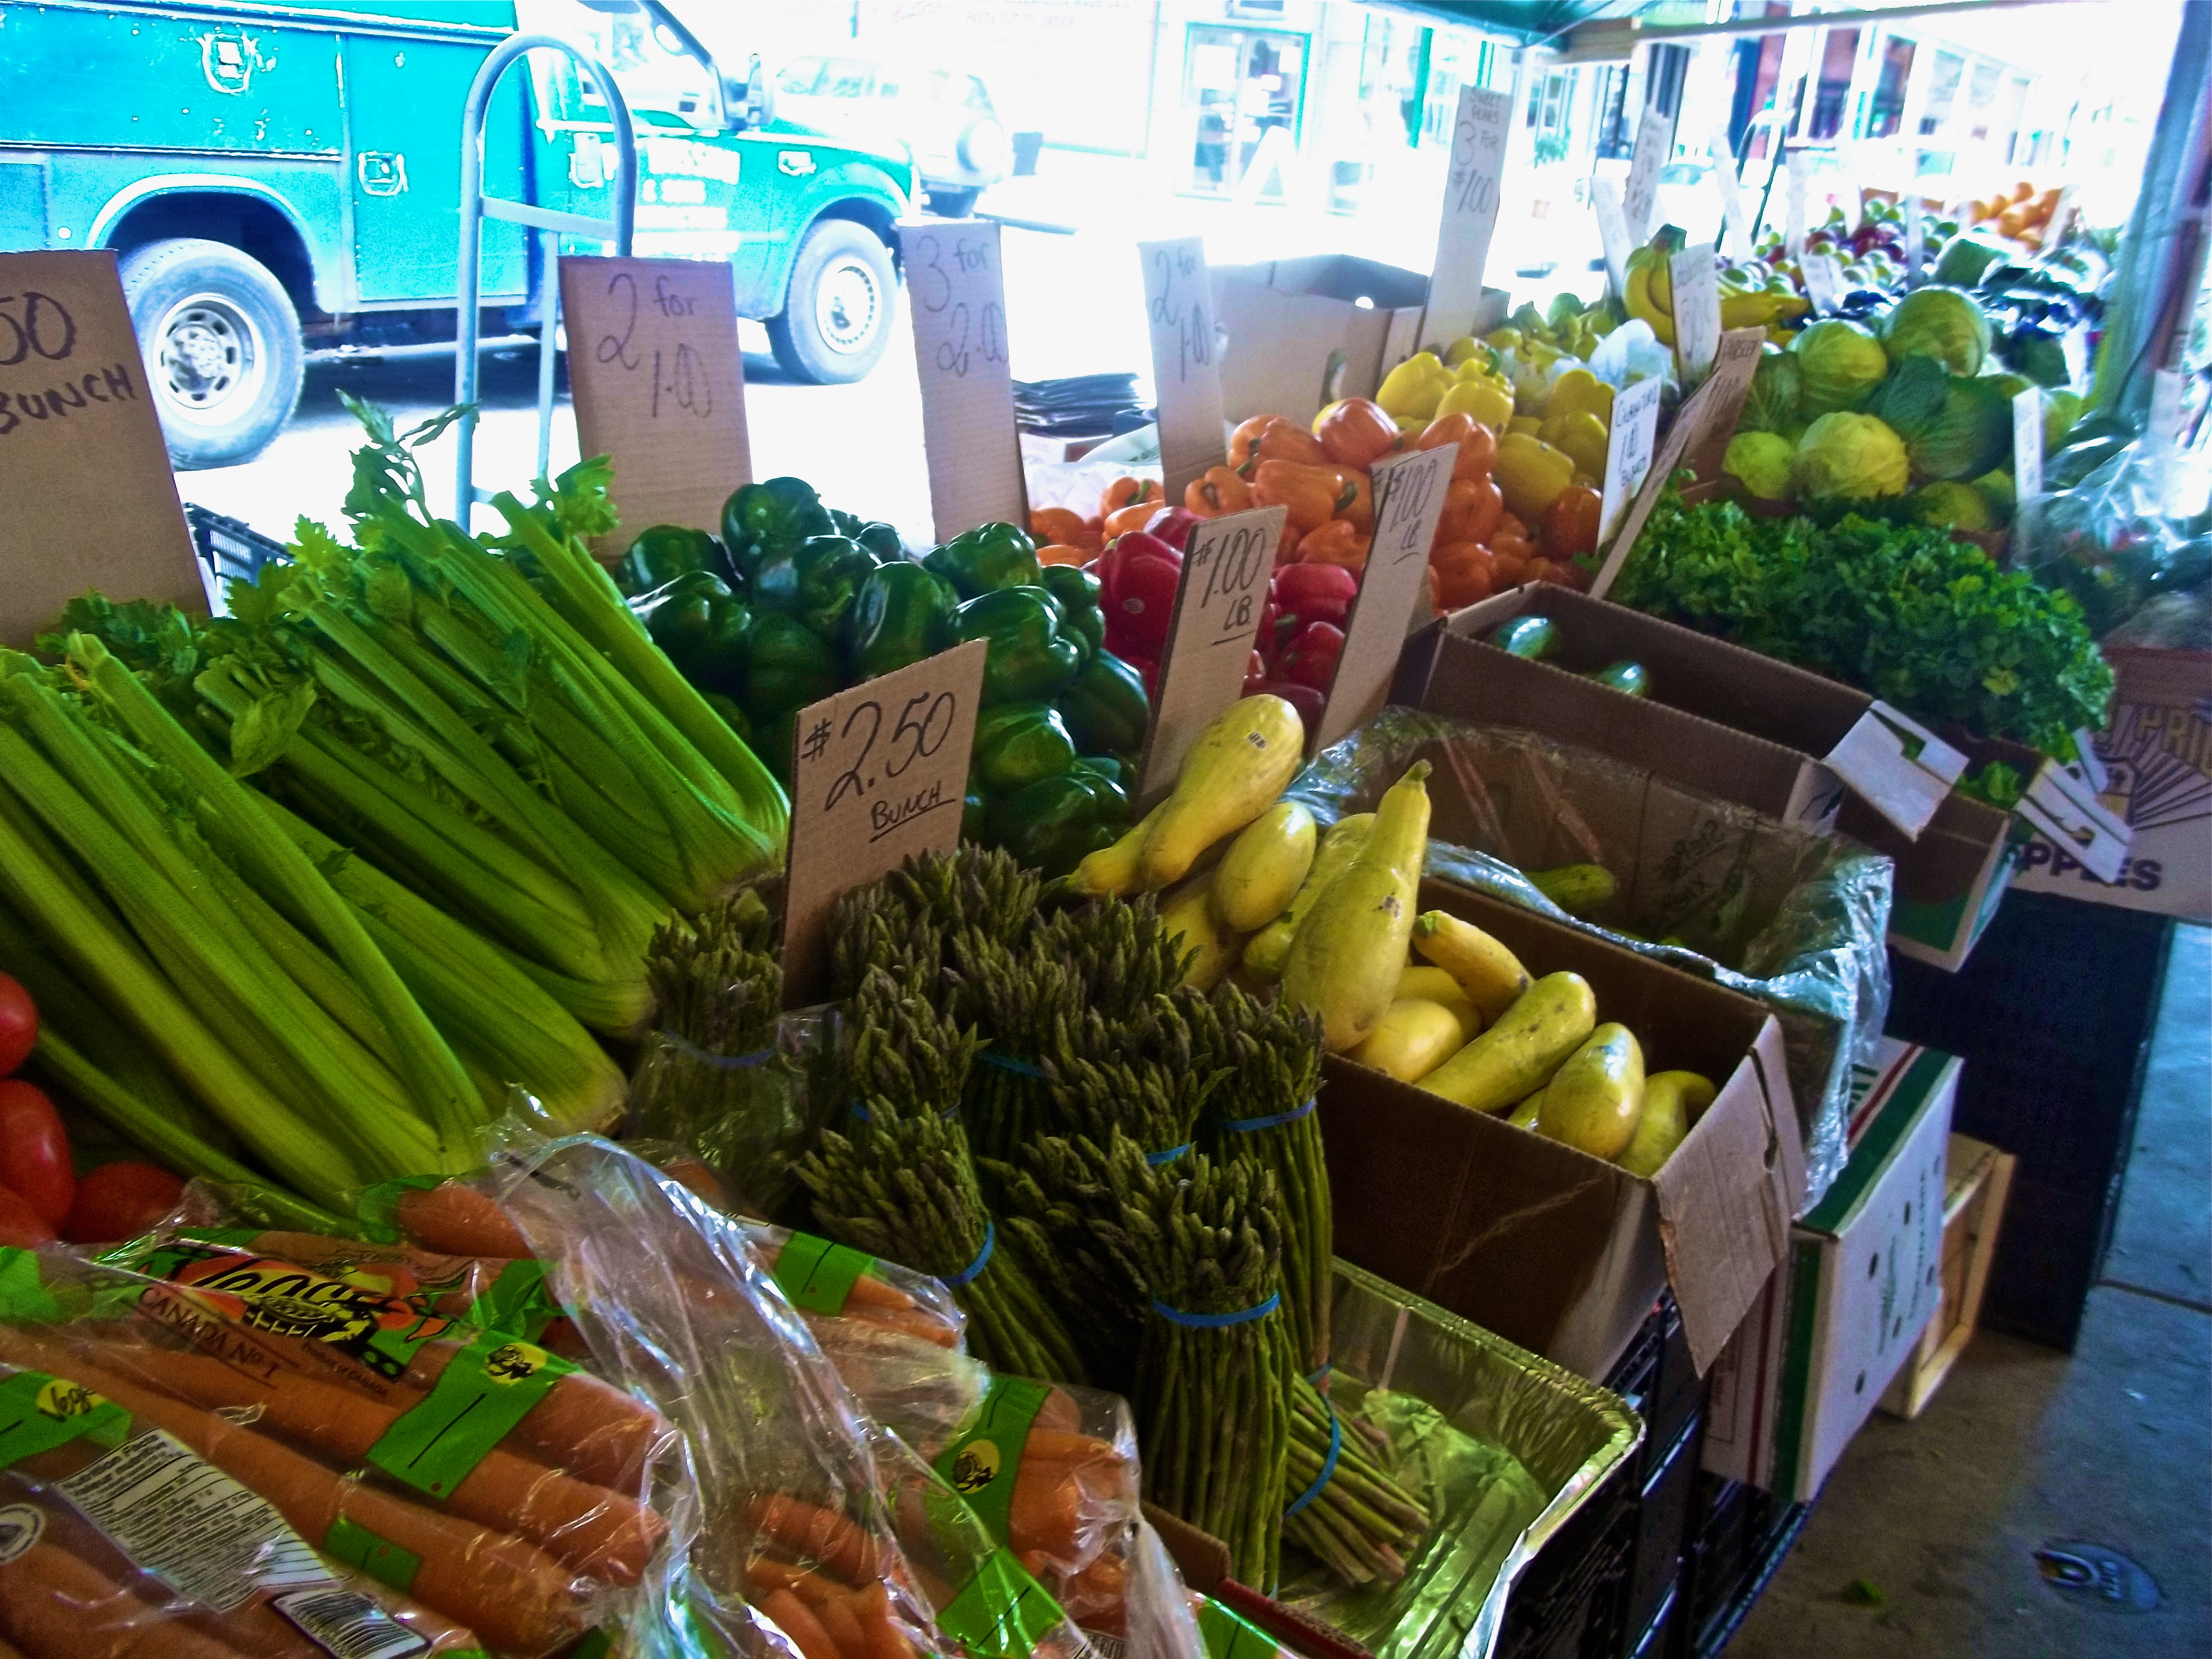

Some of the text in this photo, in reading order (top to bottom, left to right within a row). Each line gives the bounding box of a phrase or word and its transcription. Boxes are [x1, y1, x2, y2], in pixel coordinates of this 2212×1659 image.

[1455, 121, 1476, 165] 3
[916, 236, 989, 312] 3 for
[1151, 250, 1180, 327] 2
[596, 273, 697, 370] 2 for
[1191, 528, 1265, 609] $1.00
[801, 692, 955, 813] $2.50
[870, 780, 941, 831] BUNCH
[140, 1286, 229, 1352] CANADA
